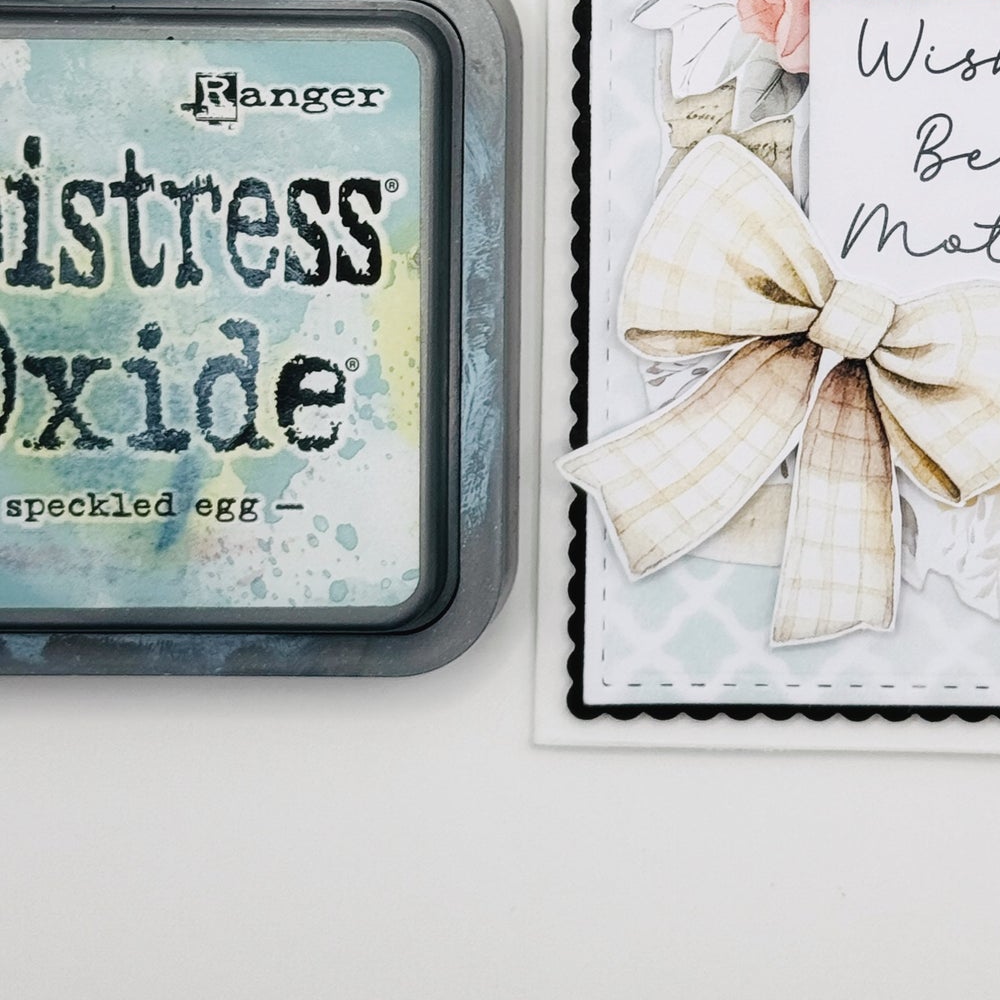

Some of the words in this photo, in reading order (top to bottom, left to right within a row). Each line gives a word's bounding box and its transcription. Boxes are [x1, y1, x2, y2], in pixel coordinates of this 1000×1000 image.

[181, 72, 385, 127] Ranger
[6, 492, 177, 522] speckled
[195, 496, 260, 523] egg
